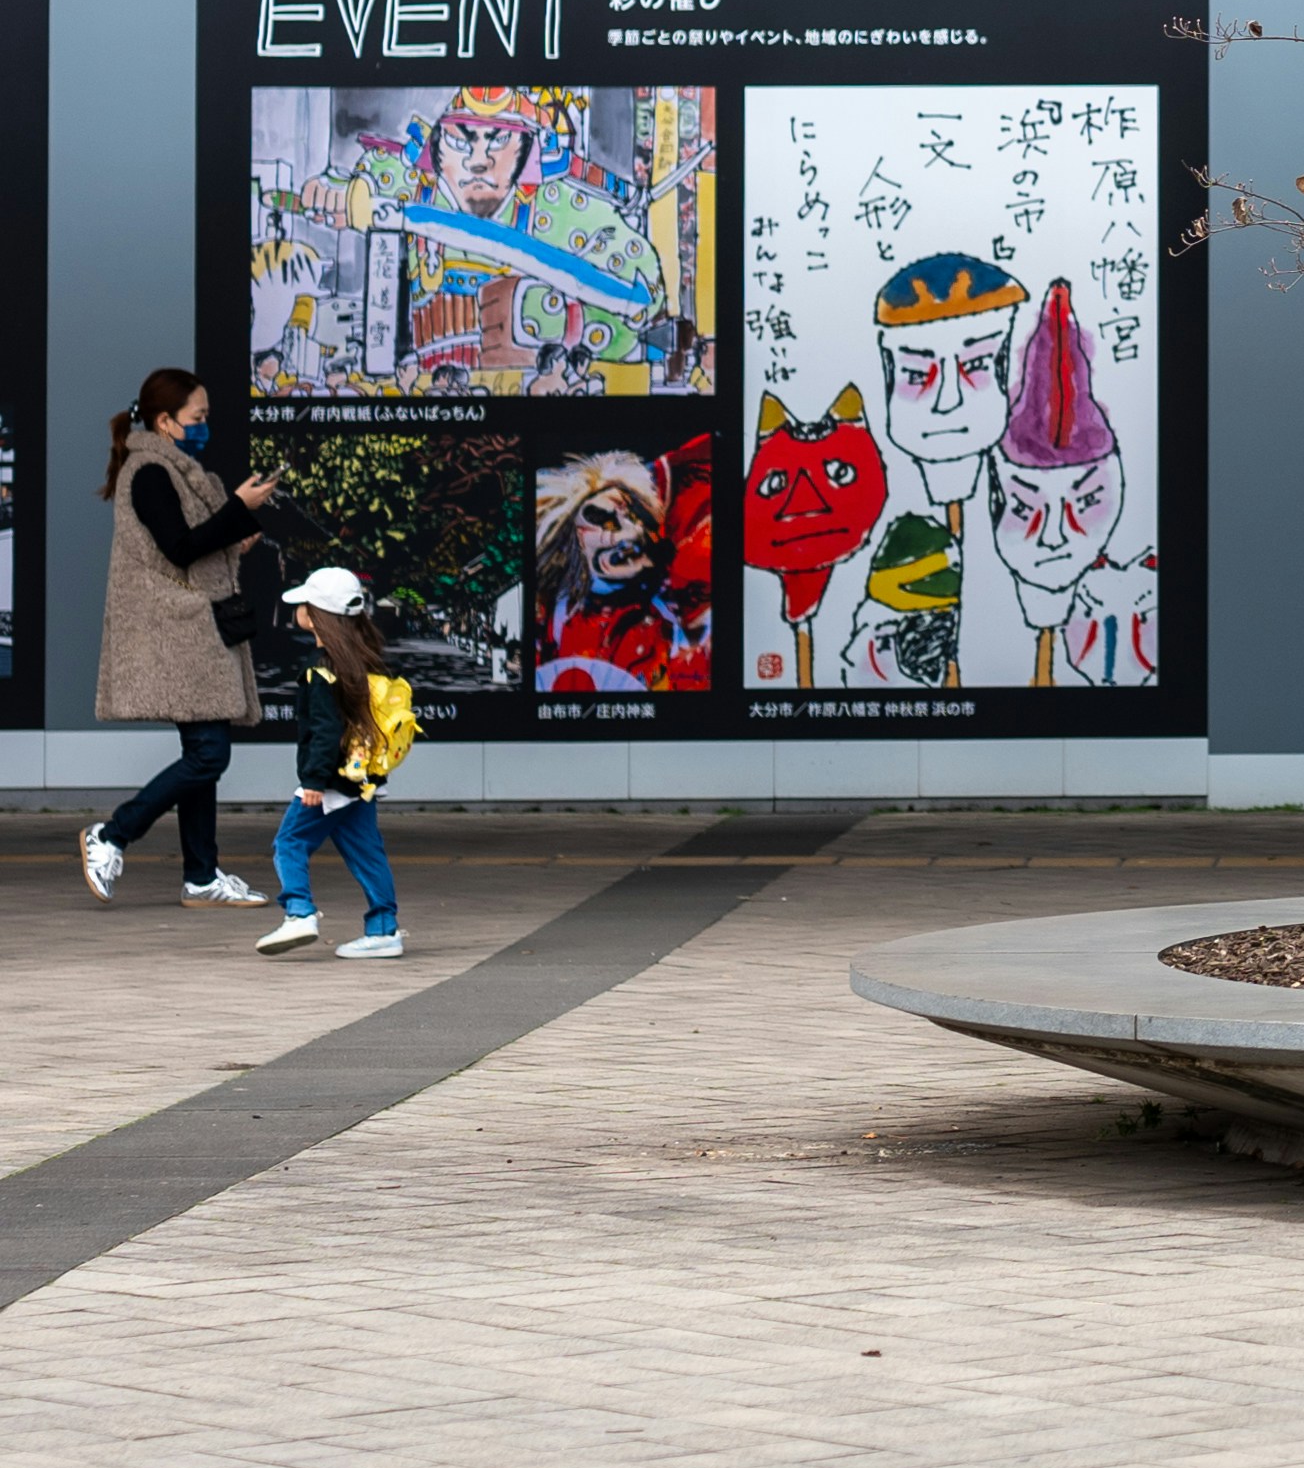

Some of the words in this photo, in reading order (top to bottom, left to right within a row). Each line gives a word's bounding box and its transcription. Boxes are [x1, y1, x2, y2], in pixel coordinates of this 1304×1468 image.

[537, 703, 656, 719] 由布市／庄内神楽
